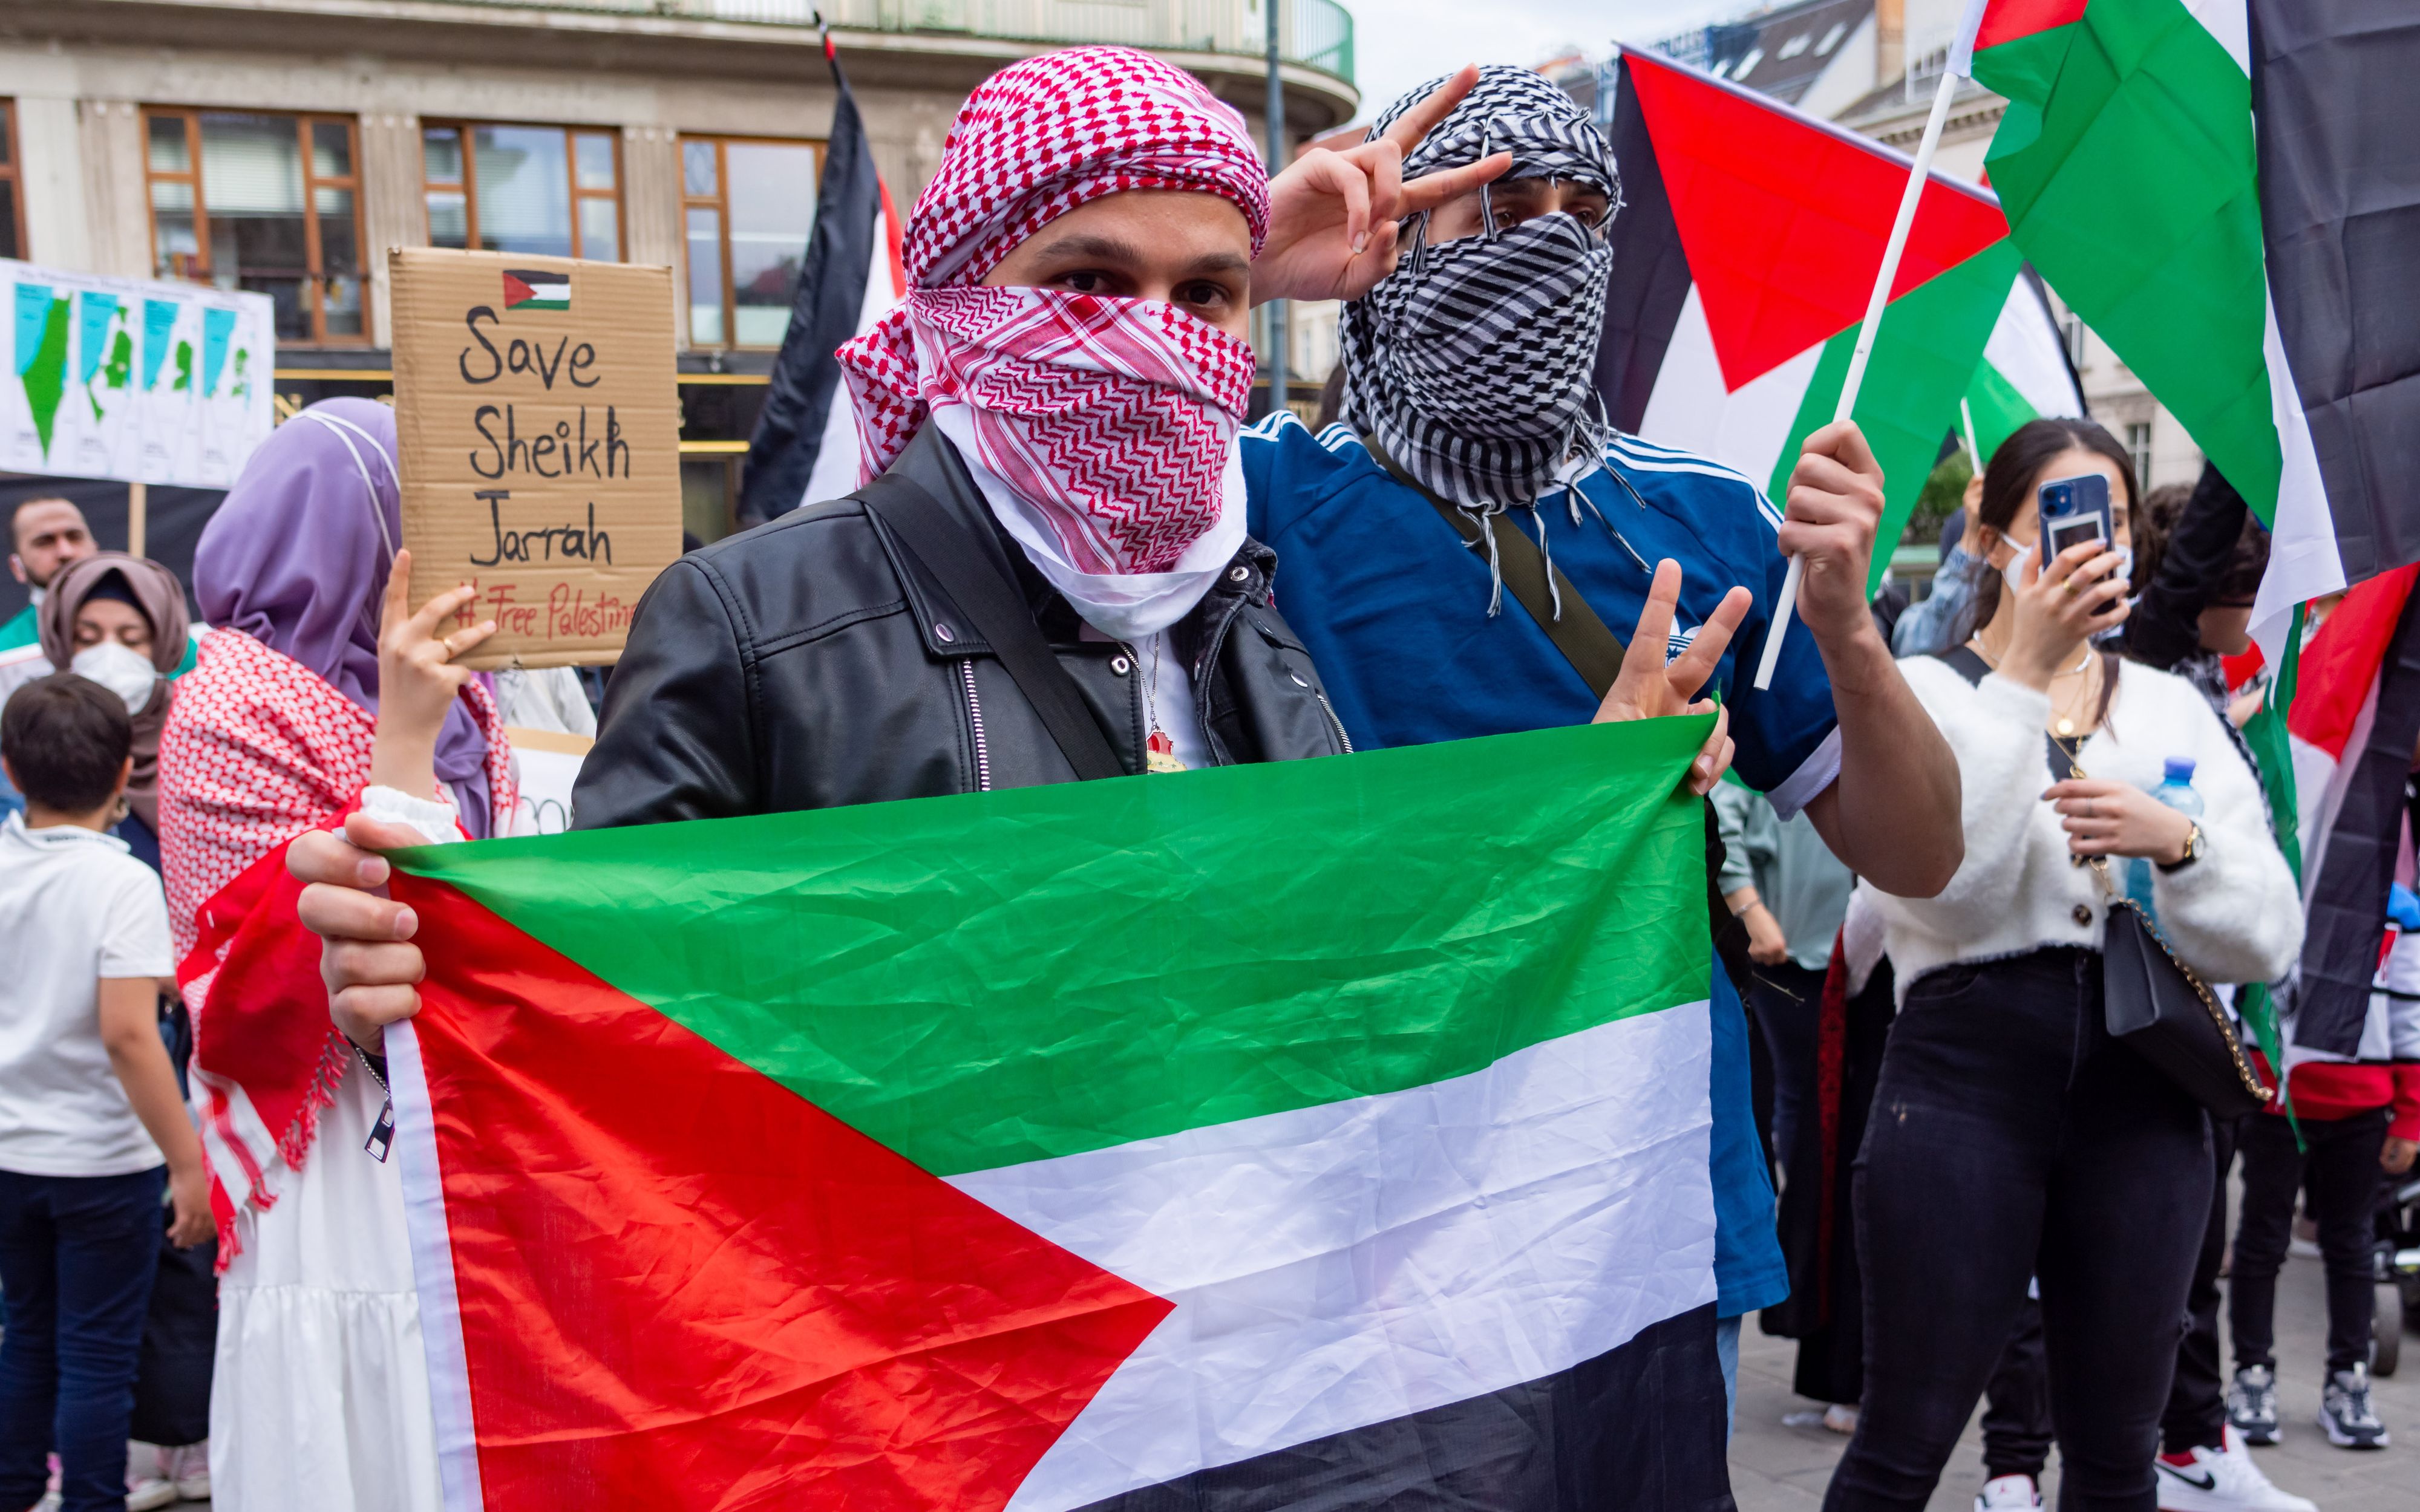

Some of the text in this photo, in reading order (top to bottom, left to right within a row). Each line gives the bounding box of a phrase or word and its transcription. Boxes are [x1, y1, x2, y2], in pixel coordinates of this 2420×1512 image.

[460, 305, 601, 391] Save
[469, 403, 630, 480] Sheikh
[469, 490, 611, 566] Jarrah
[547, 583, 638, 640] Palestin
